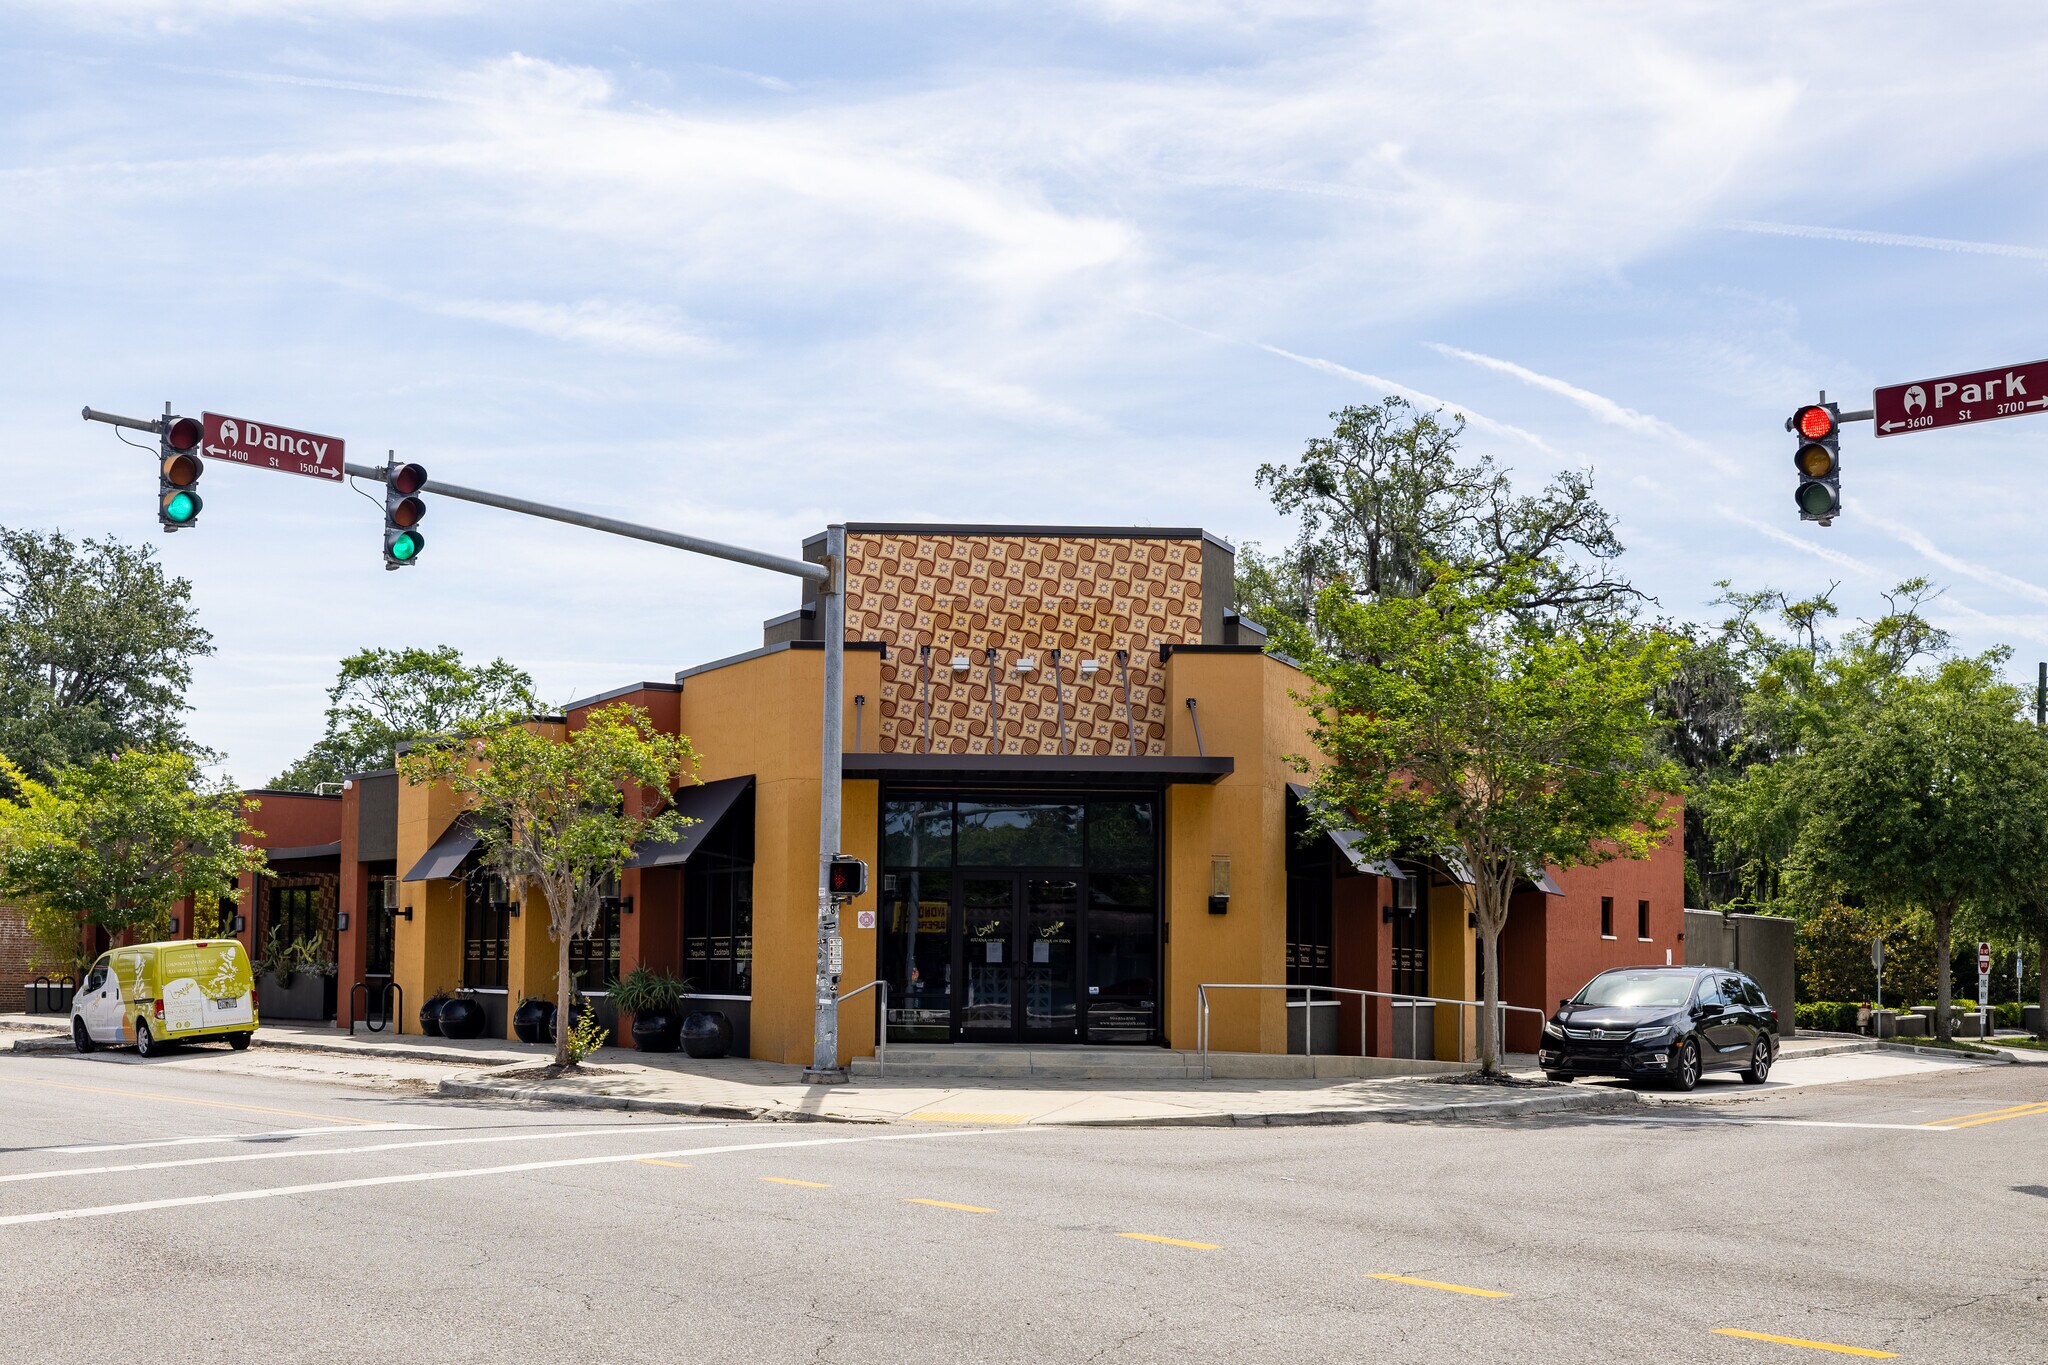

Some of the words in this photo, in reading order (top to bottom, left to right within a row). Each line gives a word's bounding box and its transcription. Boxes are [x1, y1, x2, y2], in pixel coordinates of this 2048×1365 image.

[1934, 371, 2028, 409] Park
[1907, 416, 1934, 429] 3600
[1958, 410, 1972, 421] St
[1996, 401, 2025, 415] 3700
[245, 422, 329, 465] Dancy
[228, 448, 249, 462] 1400
[269, 457, 280, 467] St
[299, 462, 320, 475] 1500
[713, 948, 730, 956] Cocktails
